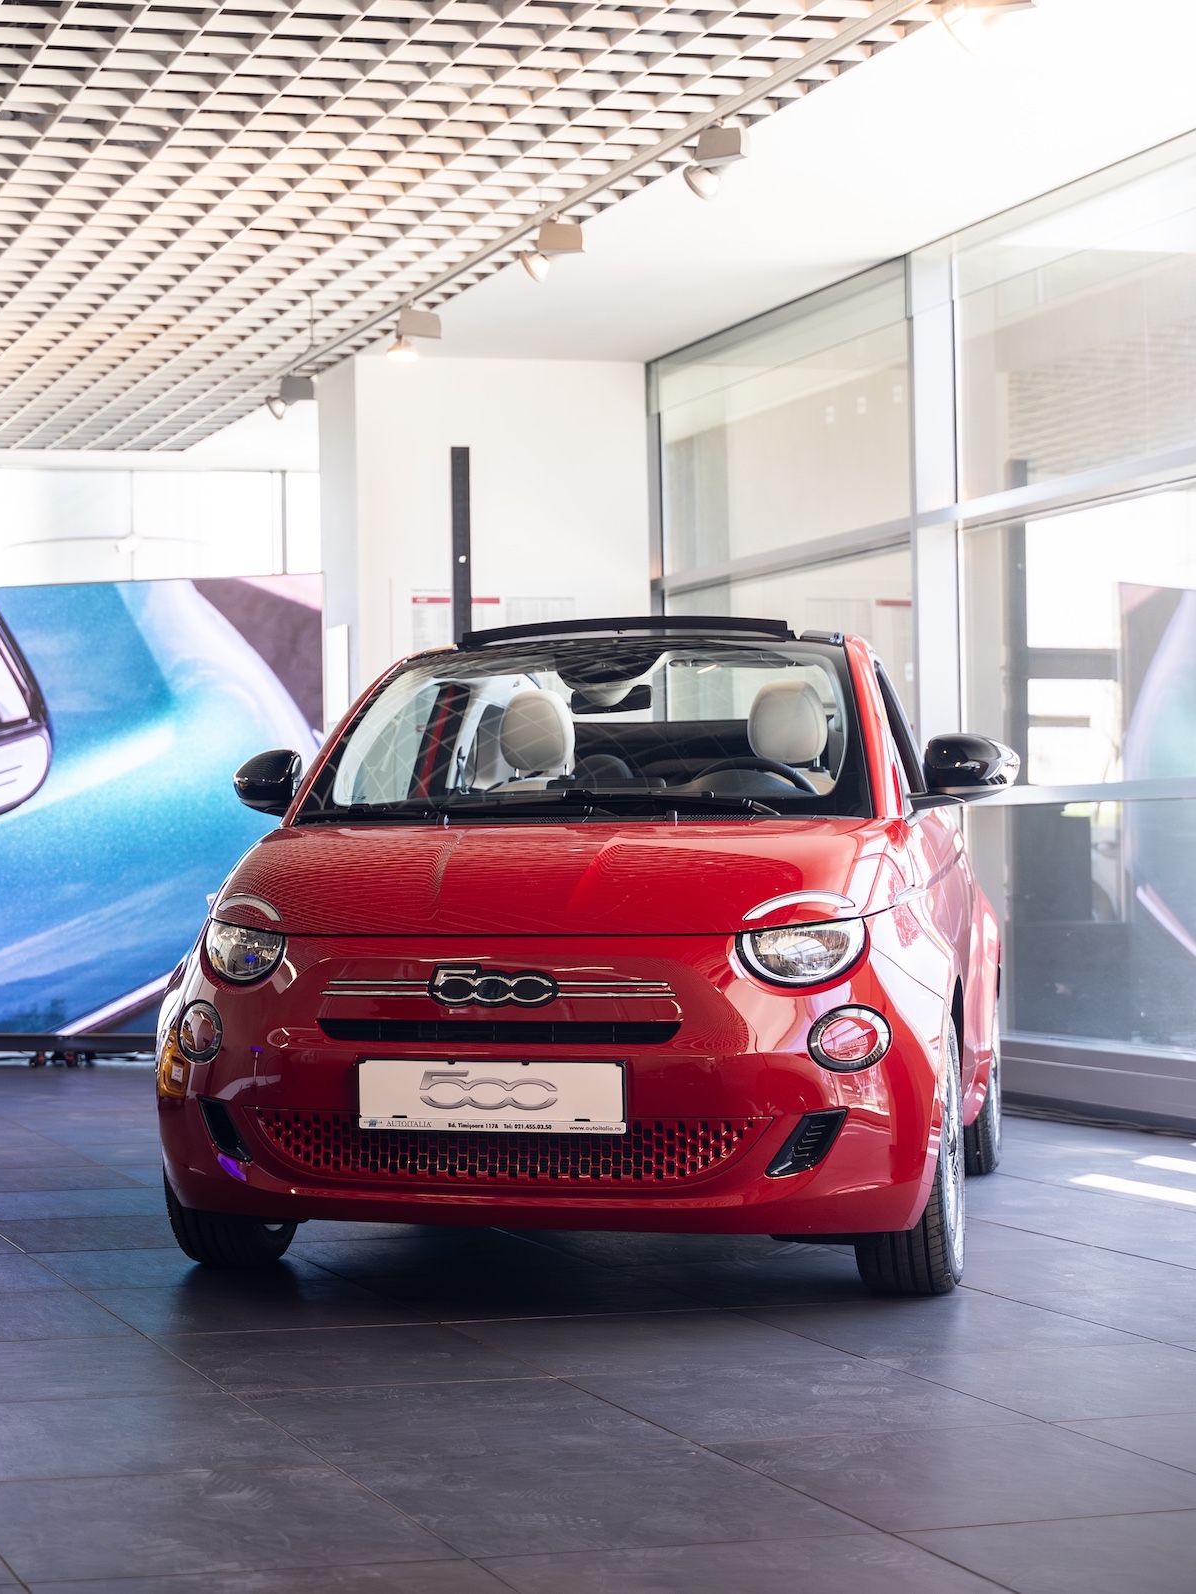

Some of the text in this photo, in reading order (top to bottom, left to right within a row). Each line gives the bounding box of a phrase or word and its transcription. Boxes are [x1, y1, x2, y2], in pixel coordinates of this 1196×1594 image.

[431, 966, 556, 1006] 500
[419, 1069, 558, 1110] 500
[386, 1120, 432, 1128] AUTOITALIA
